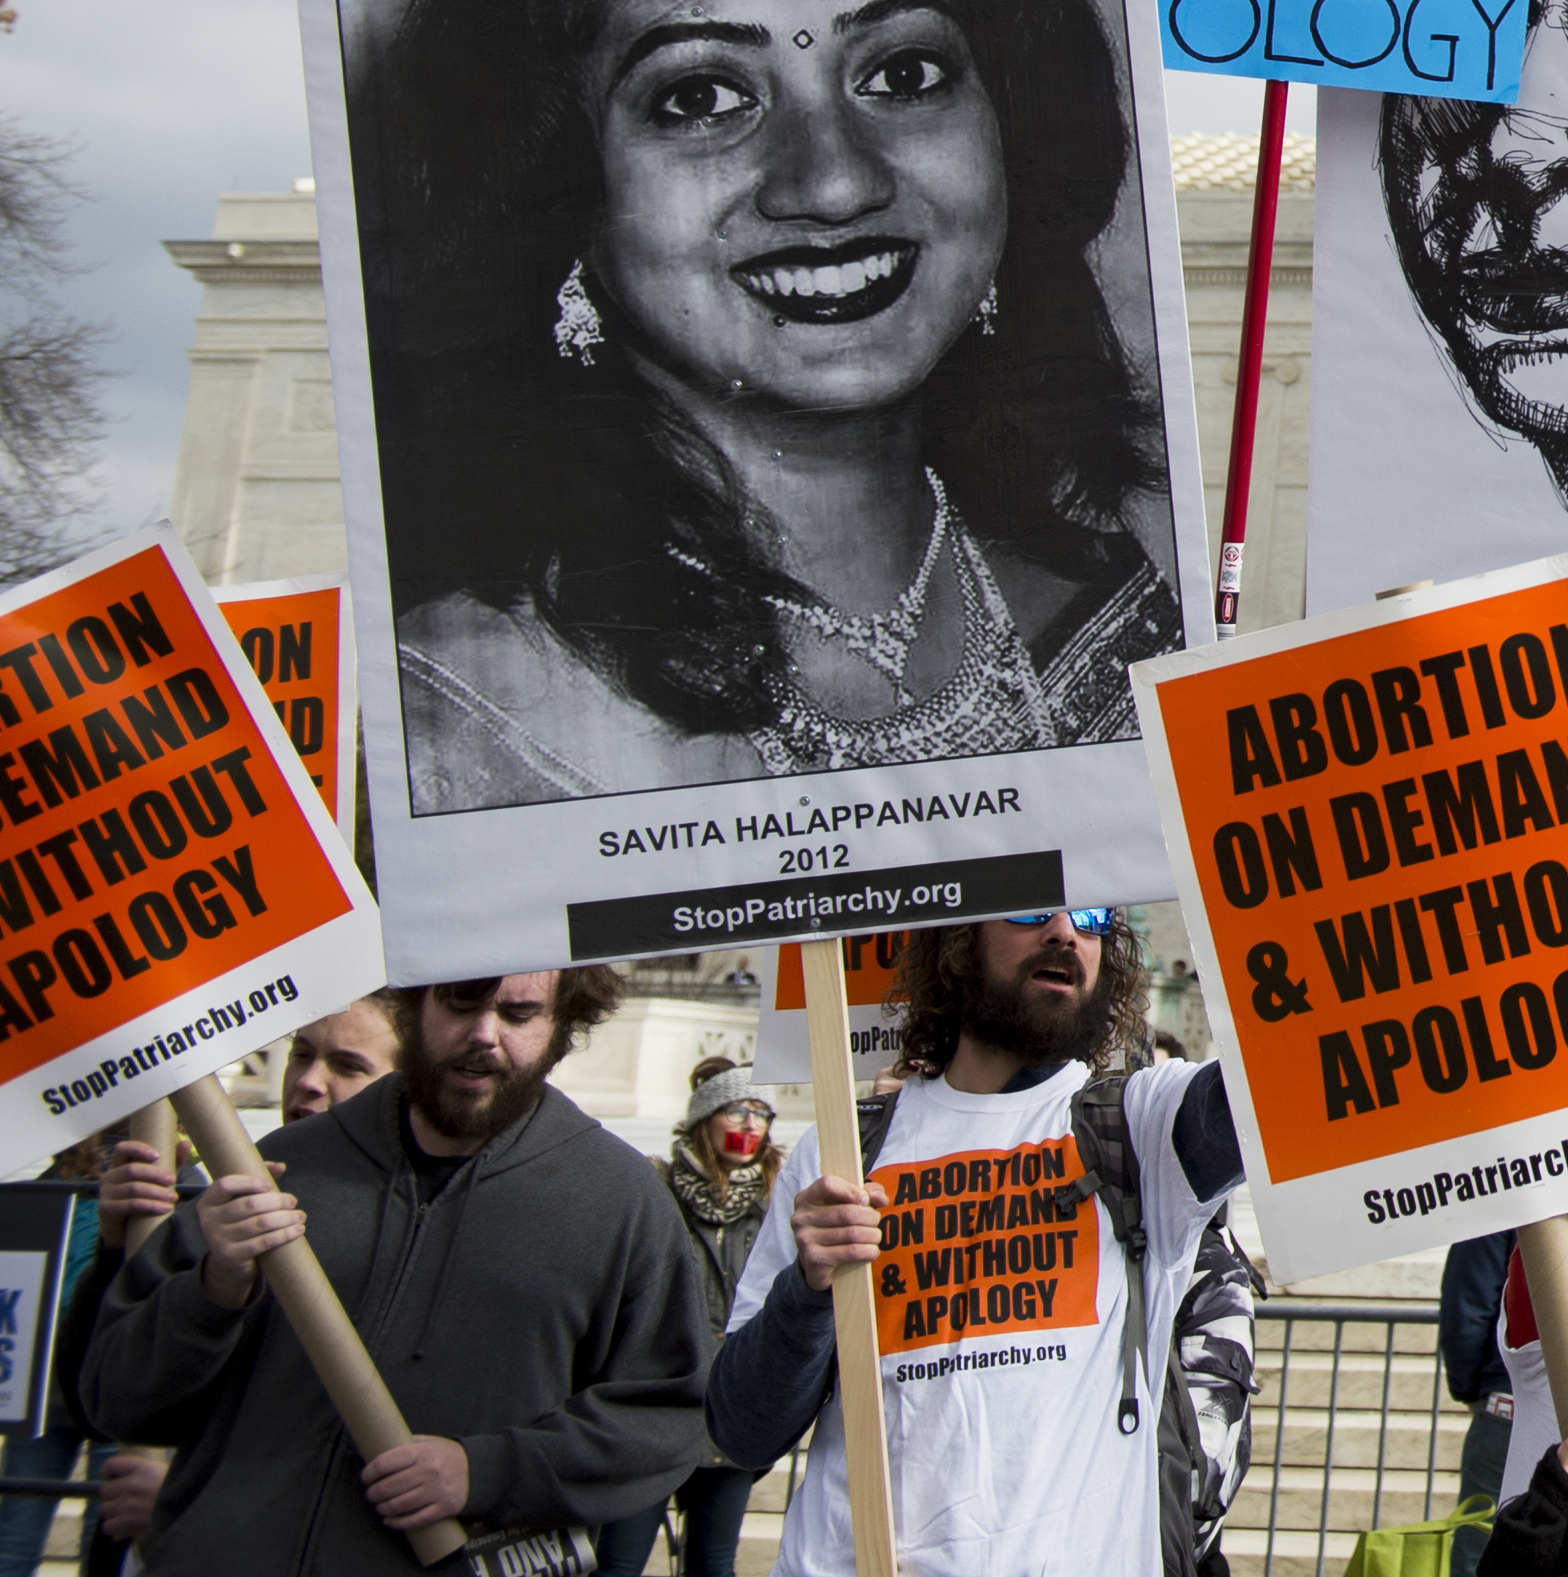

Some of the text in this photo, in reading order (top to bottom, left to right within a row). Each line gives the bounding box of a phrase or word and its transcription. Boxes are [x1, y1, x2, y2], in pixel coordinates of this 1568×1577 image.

[598, 787, 1021, 859] SAVITA HALAPPANAVAR
[778, 844, 851, 874] 2012
[1213, 806, 1322, 911] ON
[672, 879, 962, 933] StopPatriarchy.org
[1245, 941, 1313, 1023] &
[42, 973, 299, 1116] StopPatriarchy.org
[894, 1148, 1066, 1207] ABORTION
[878, 1207, 924, 1251] ON
[881, 1229, 1078, 1298] & WITHOUT
[903, 1278, 1059, 1341] APOLOGY
